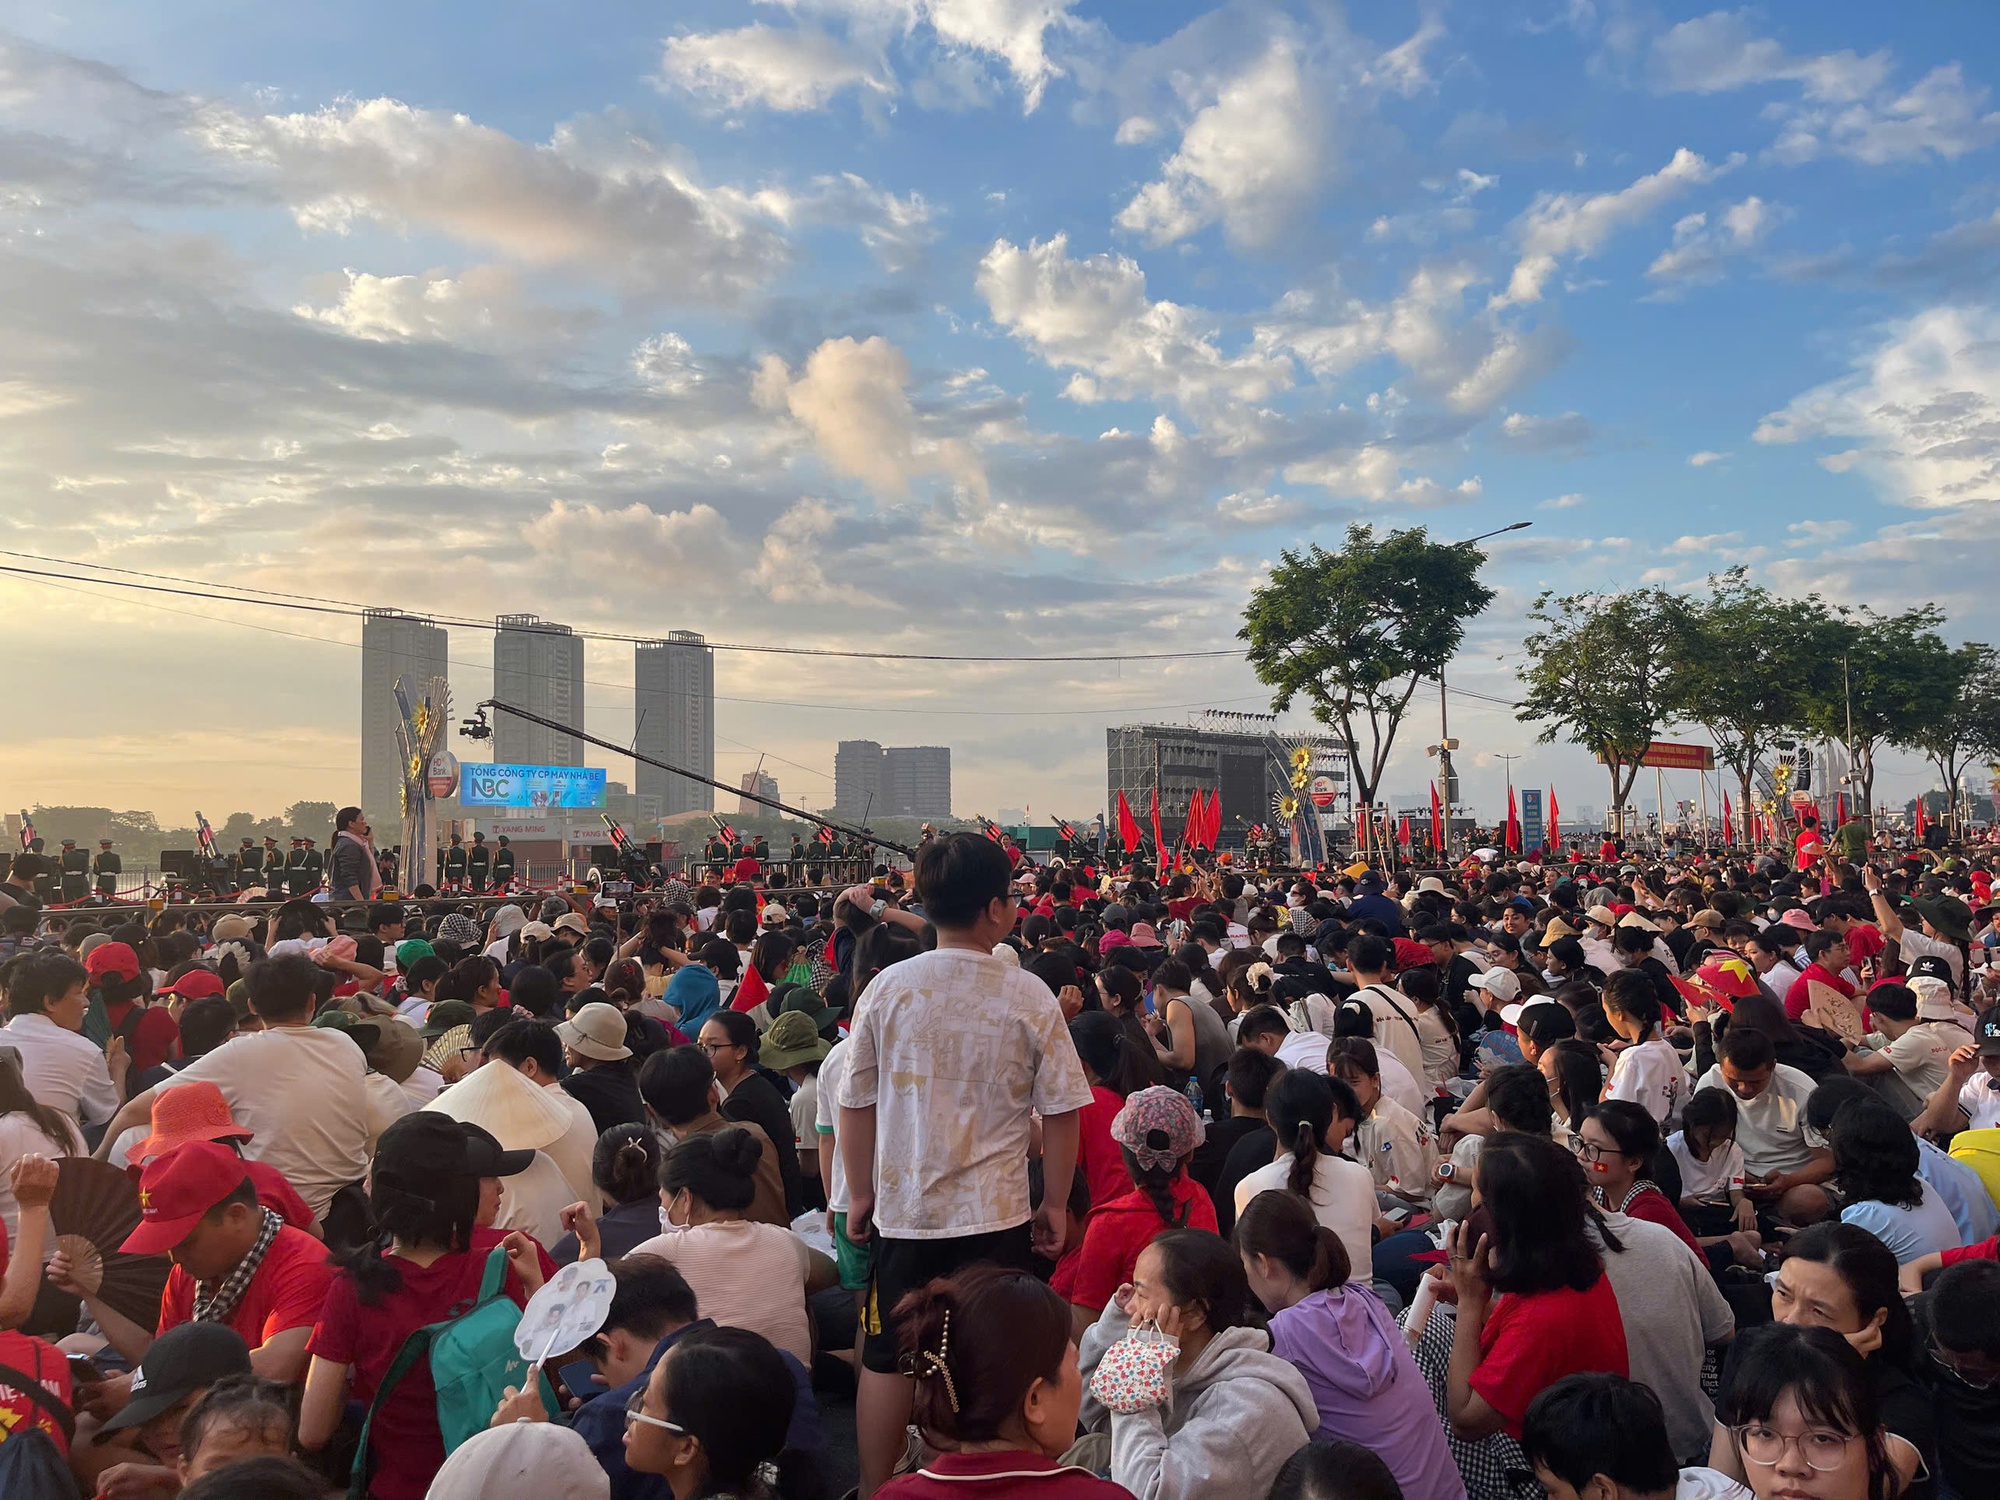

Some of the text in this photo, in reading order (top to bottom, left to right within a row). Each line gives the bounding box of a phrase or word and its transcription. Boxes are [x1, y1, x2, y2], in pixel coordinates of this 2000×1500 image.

[433, 758, 441, 767] HD
[433, 767, 446, 776] Bank
[526, 770, 537, 778] TY
[538, 770, 550, 779] CP
[550, 771, 569, 780] MAY
[471, 778, 510, 799] NBC
[501, 825, 546, 833] YANG MING
[581, 830, 601, 838] YANG
